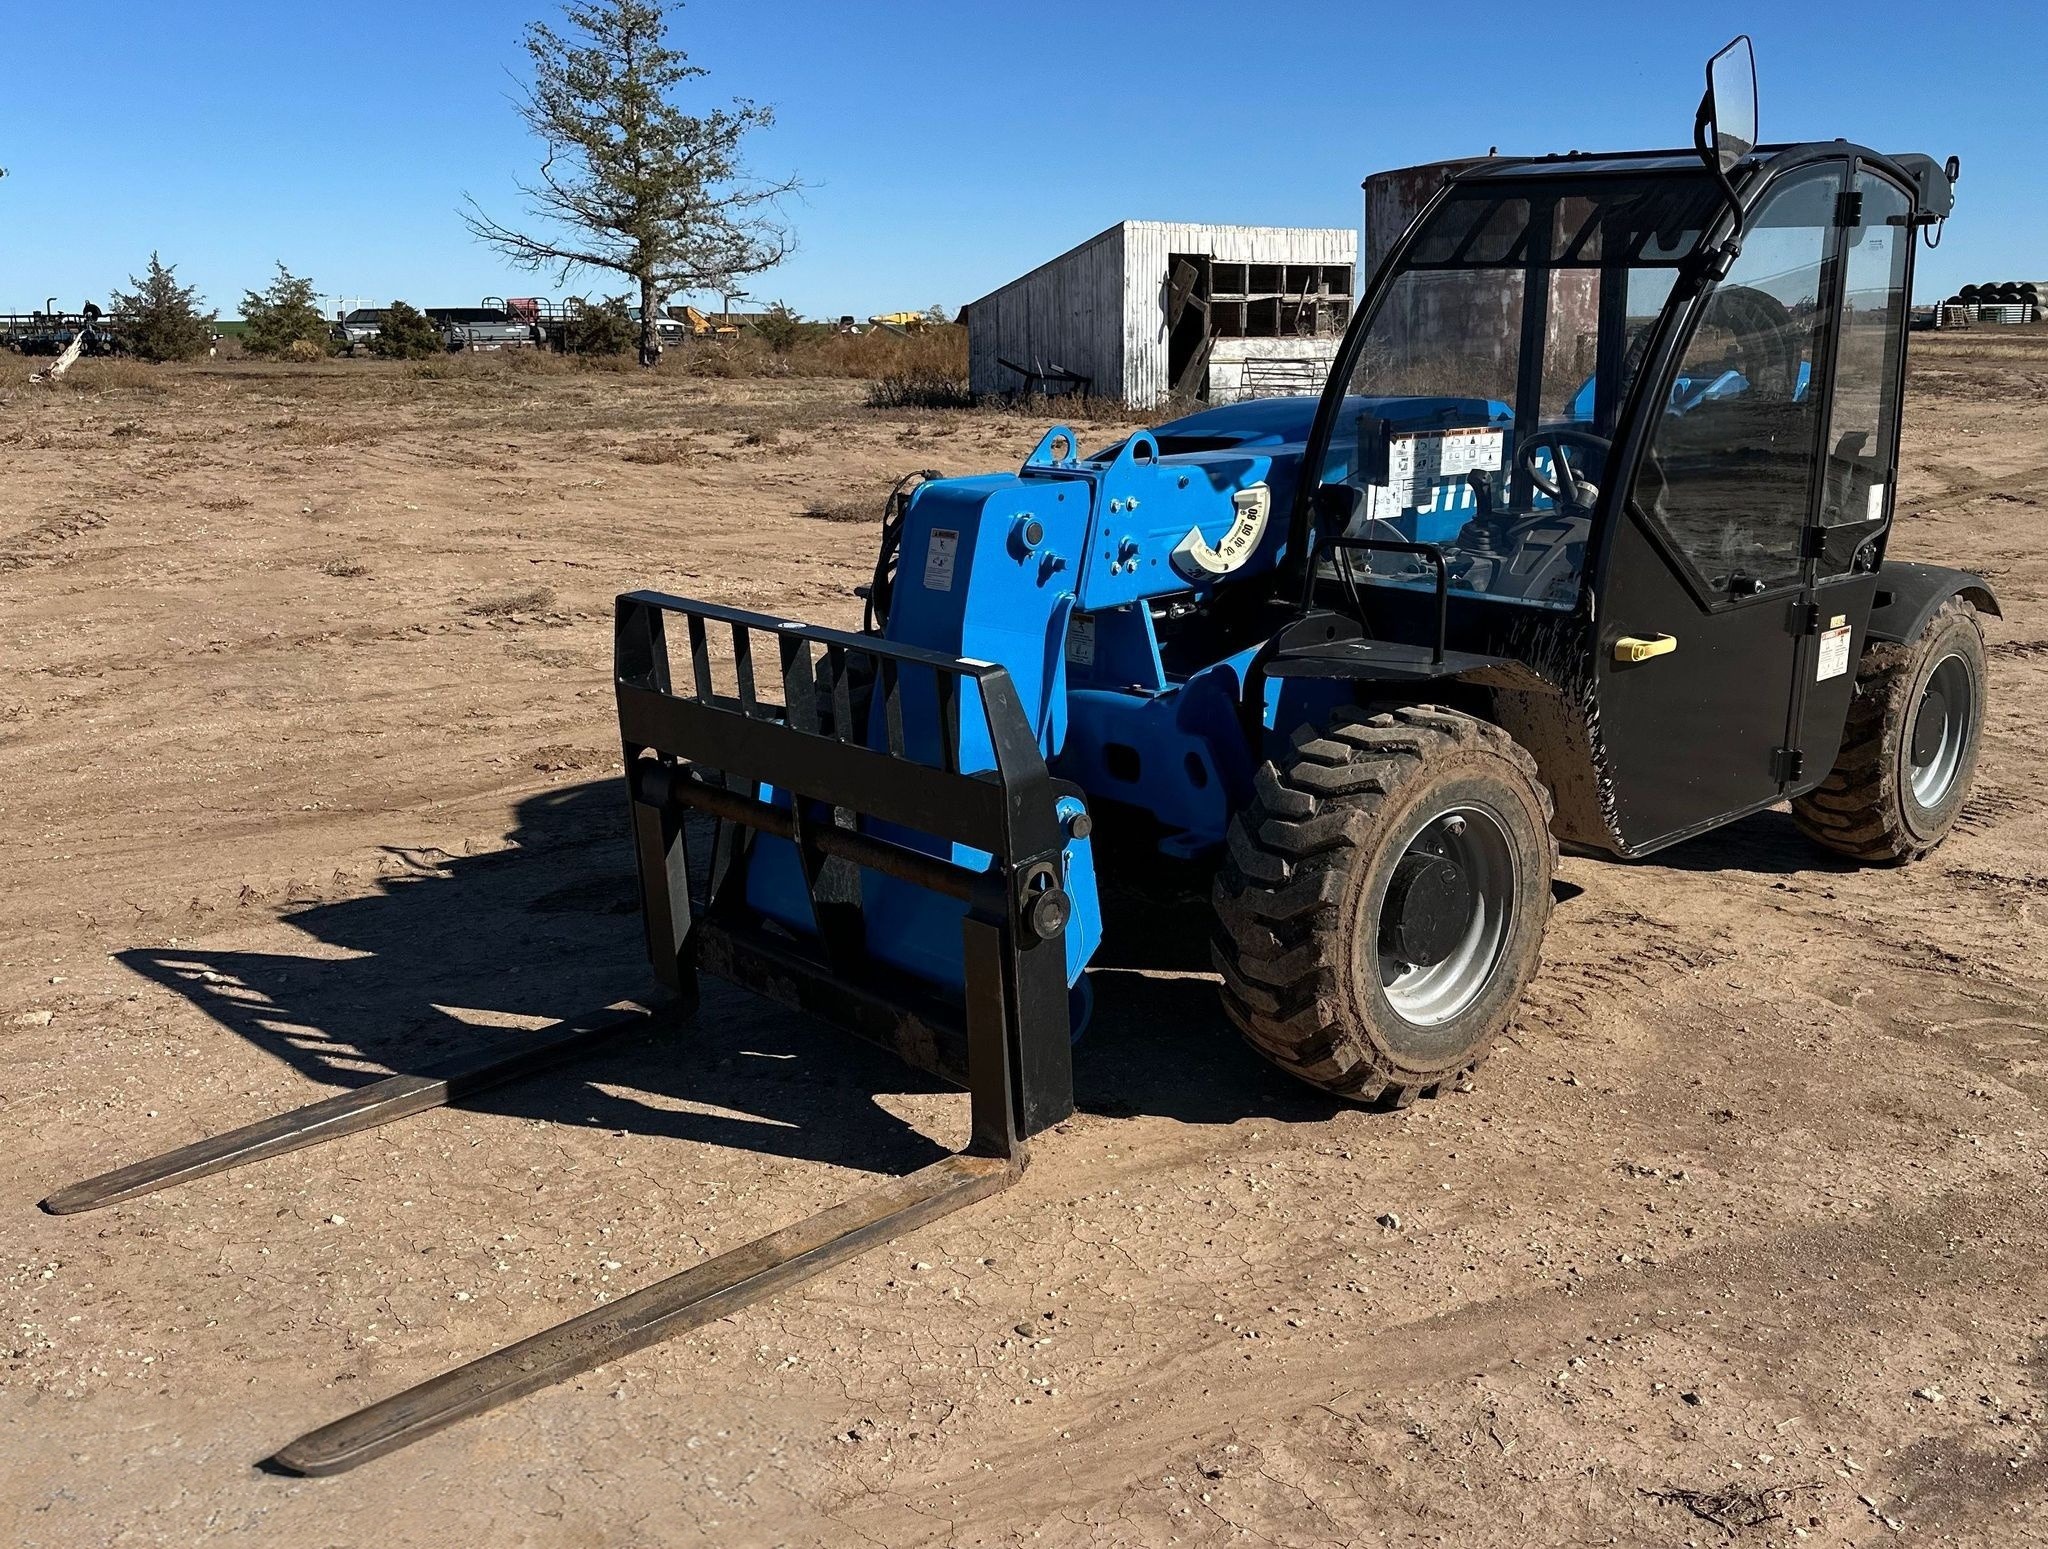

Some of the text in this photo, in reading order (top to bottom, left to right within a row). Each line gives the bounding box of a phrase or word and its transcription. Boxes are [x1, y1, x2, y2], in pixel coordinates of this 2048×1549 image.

[1247, 508, 1258, 521] 80
[1242, 524, 1254, 536] 60
[1234, 537, 1246, 548] 40
[1223, 546, 1235, 556] 20
